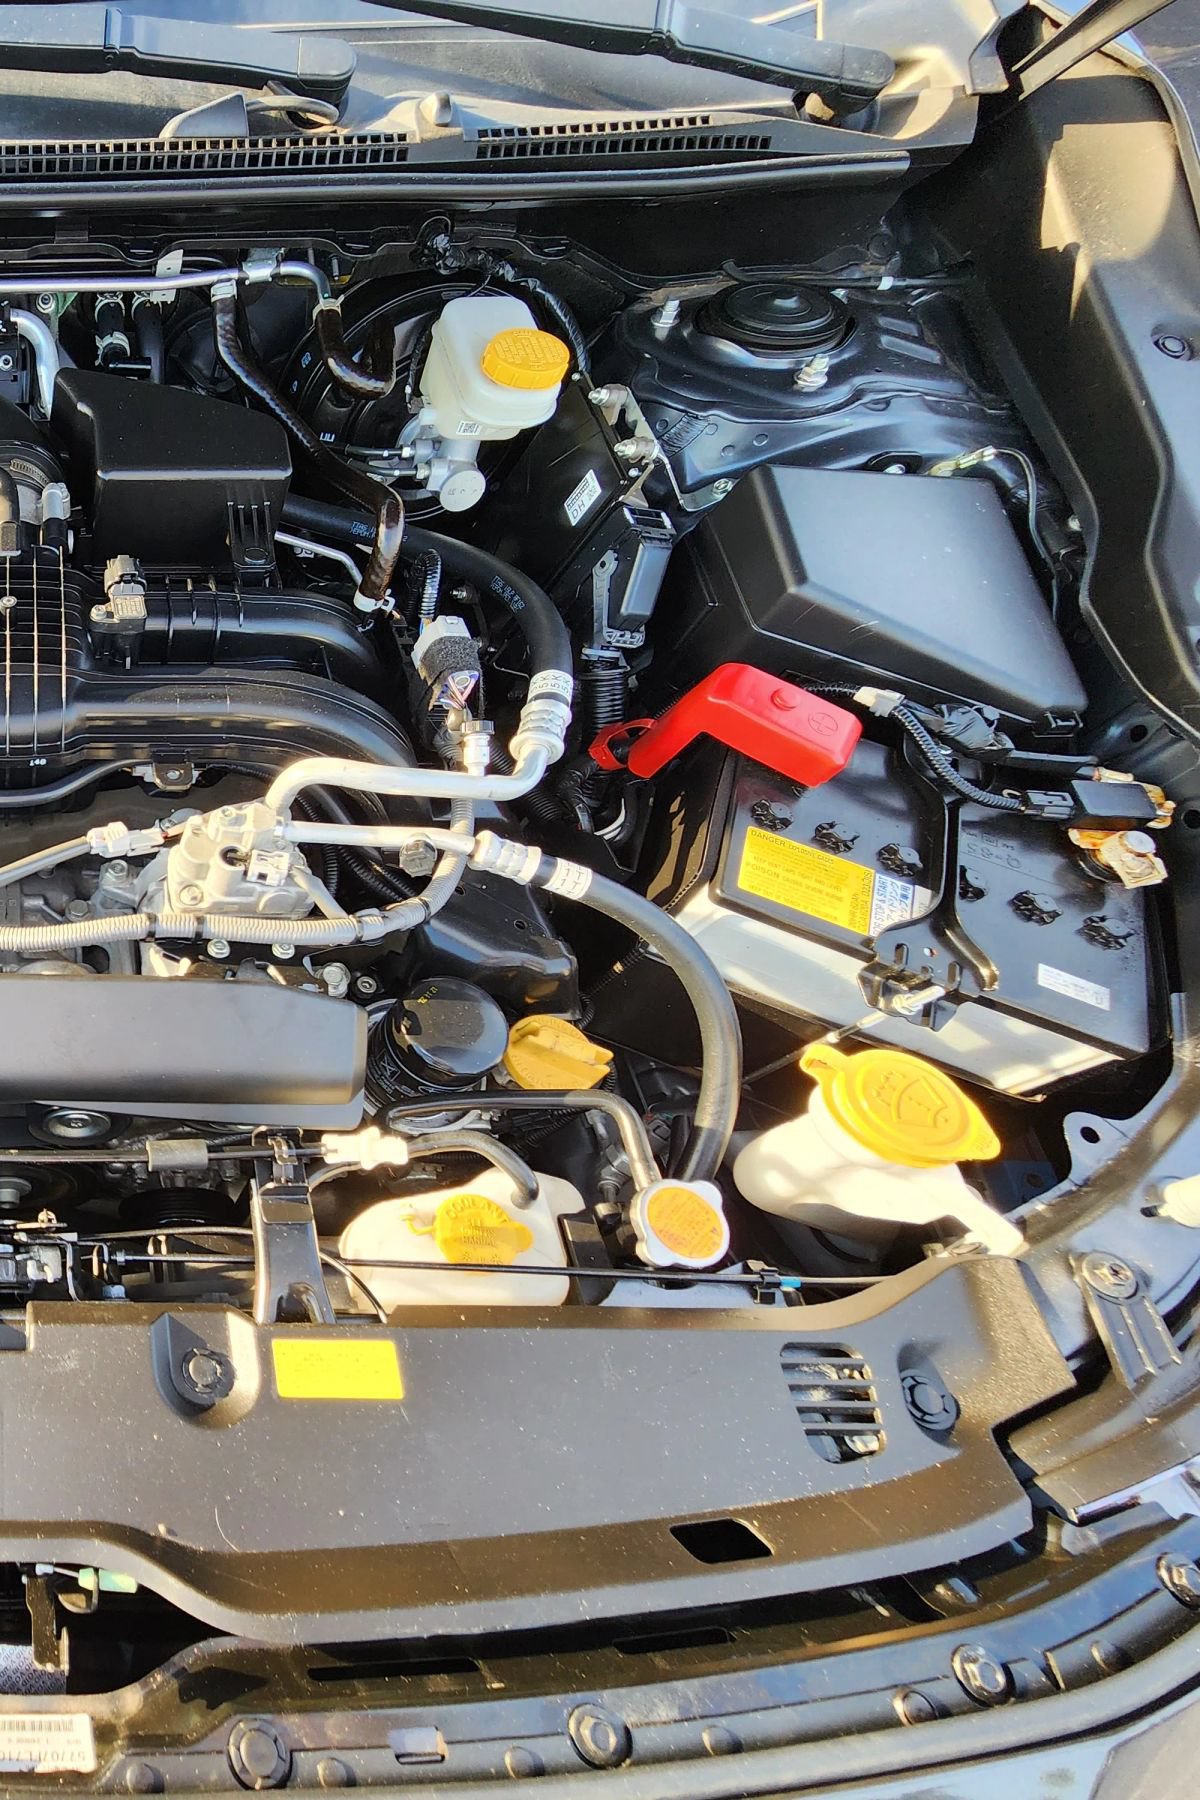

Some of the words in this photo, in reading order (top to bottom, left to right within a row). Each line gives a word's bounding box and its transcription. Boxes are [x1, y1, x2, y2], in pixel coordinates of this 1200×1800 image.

[570, 499, 586, 520] DH
[751, 829, 787, 847] DANGER
[876, 875, 889, 898] START
[874, 903, 886, 922] STOP
[445, 1196, 511, 1224] COOLANT
